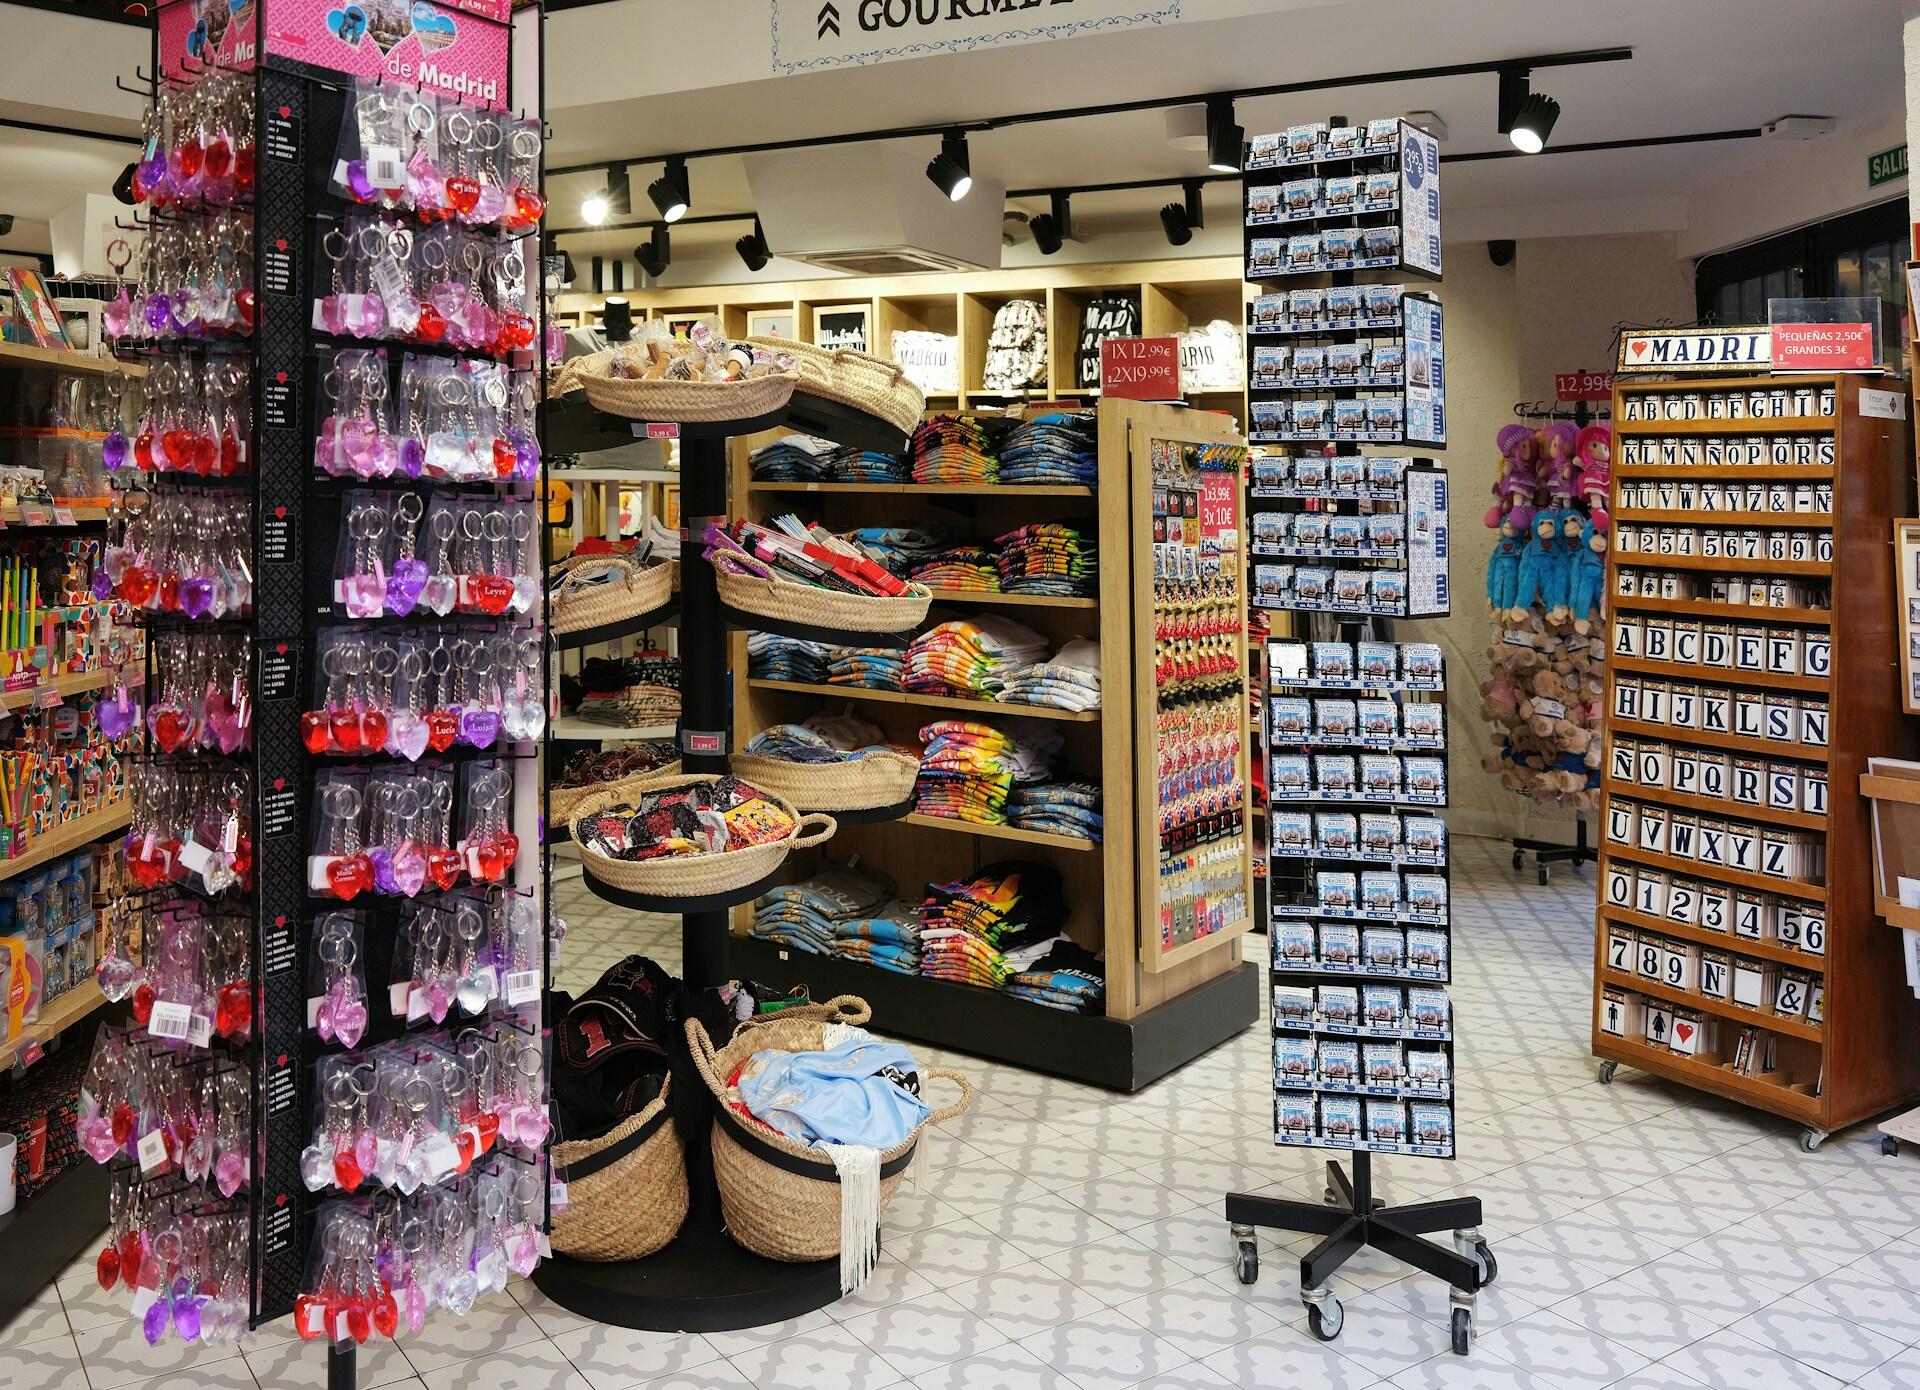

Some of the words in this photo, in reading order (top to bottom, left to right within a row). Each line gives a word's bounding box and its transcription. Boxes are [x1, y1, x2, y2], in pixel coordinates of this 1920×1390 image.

[218, 44, 231, 66] de
[388, 54, 412, 77] de
[418, 61, 497, 101] Madrid
[1780, 331, 1833, 341] PEQUEÑAS
[1836, 331, 1864, 342] 2,50€
[900, 349, 947, 367] MADRID
[1785, 346, 1833, 354] GRANDES
[1835, 346, 1847, 354] 3€
[1558, 376, 1612, 394] 12,99€
[1627, 403, 1637, 420] A
[1645, 402, 1656, 420] B
[1667, 402, 1678, 419] C
[1684, 401, 1696, 418] D
[1711, 401, 1722, 418] E
[1729, 400, 1741, 417] F
[1751, 400, 1764, 417] G
[1771, 398, 1783, 417] H
[1823, 398, 1834, 416] J
[1625, 447, 1637, 463] K
[1643, 446, 1654, 464] L
[1663, 446, 1676, 464] M
[1683, 446, 1695, 464] N
[1708, 446, 1722, 464] Ñ
[1728, 447, 1740, 464] O
[1747, 445, 1760, 464] P
[1776, 445, 1789, 464] Q
[1797, 445, 1810, 464] R
[1820, 445, 1833, 464] S
[1623, 491, 1634, 508] T
[1639, 490, 1650, 508] U
[1660, 491, 1672, 508] V
[1680, 491, 1693, 509] W
[1703, 492, 1716, 511] X
[1726, 492, 1740, 511] Y
[1750, 492, 1761, 511] Z
[1772, 494, 1785, 512] &
[1217, 507, 1232, 525] 10€
[1620, 534, 1627, 550] 1
[1643, 535, 1653, 552] 2
[1662, 536, 1672, 552] 3
[1679, 536, 1691, 554] 4
[1706, 537, 1717, 556] 5
[1726, 539, 1736, 556] 6
[1745, 539, 1756, 557] 7
[1772, 541, 1783, 559] 8
[1793, 541, 1803, 560] 9
[485, 586, 506, 597] Leyre
[1616, 627, 1633, 652] A
[1650, 629, 1665, 655] B
[1678, 633, 1695, 659] C
[1707, 636, 1724, 662] D
[1740, 639, 1758, 667] E
[1772, 641, 1792, 668] F
[1810, 644, 1830, 671] G
[1618, 688, 1636, 715] H
[1652, 693, 1659, 719] I
[1676, 697, 1692, 723] J
[1706, 701, 1725, 728] K
[1740, 704, 1758, 733] L
[1770, 709, 1788, 737] S
[1805, 713, 1825, 742] N
[1615, 751, 1632, 777] Ñ
[1644, 755, 1659, 781] O
[1677, 760, 1695, 787] P
[1705, 766, 1723, 793] Q
[1739, 770, 1757, 799] R
[1774, 776, 1793, 804] S
[1808, 781, 1827, 810] T
[1611, 811, 1629, 839] U
[1644, 819, 1662, 846] V
[1674, 826, 1693, 853] W
[1703, 832, 1722, 861] X
[1734, 837, 1751, 864] Y
[1767, 843, 1784, 873] Z
[1644, 884, 1653, 910] 1
[1671, 892, 1690, 918] 2
[1706, 897, 1722, 926] 3
[1741, 906, 1759, 934] 4
[1783, 912, 1800, 939] 5
[1806, 920, 1823, 949] 6
[1612, 940, 1627, 966] 7
[1643, 948, 1658, 975] 8
[1668, 956, 1682, 983] 9
[1780, 983, 1801, 1011] &
